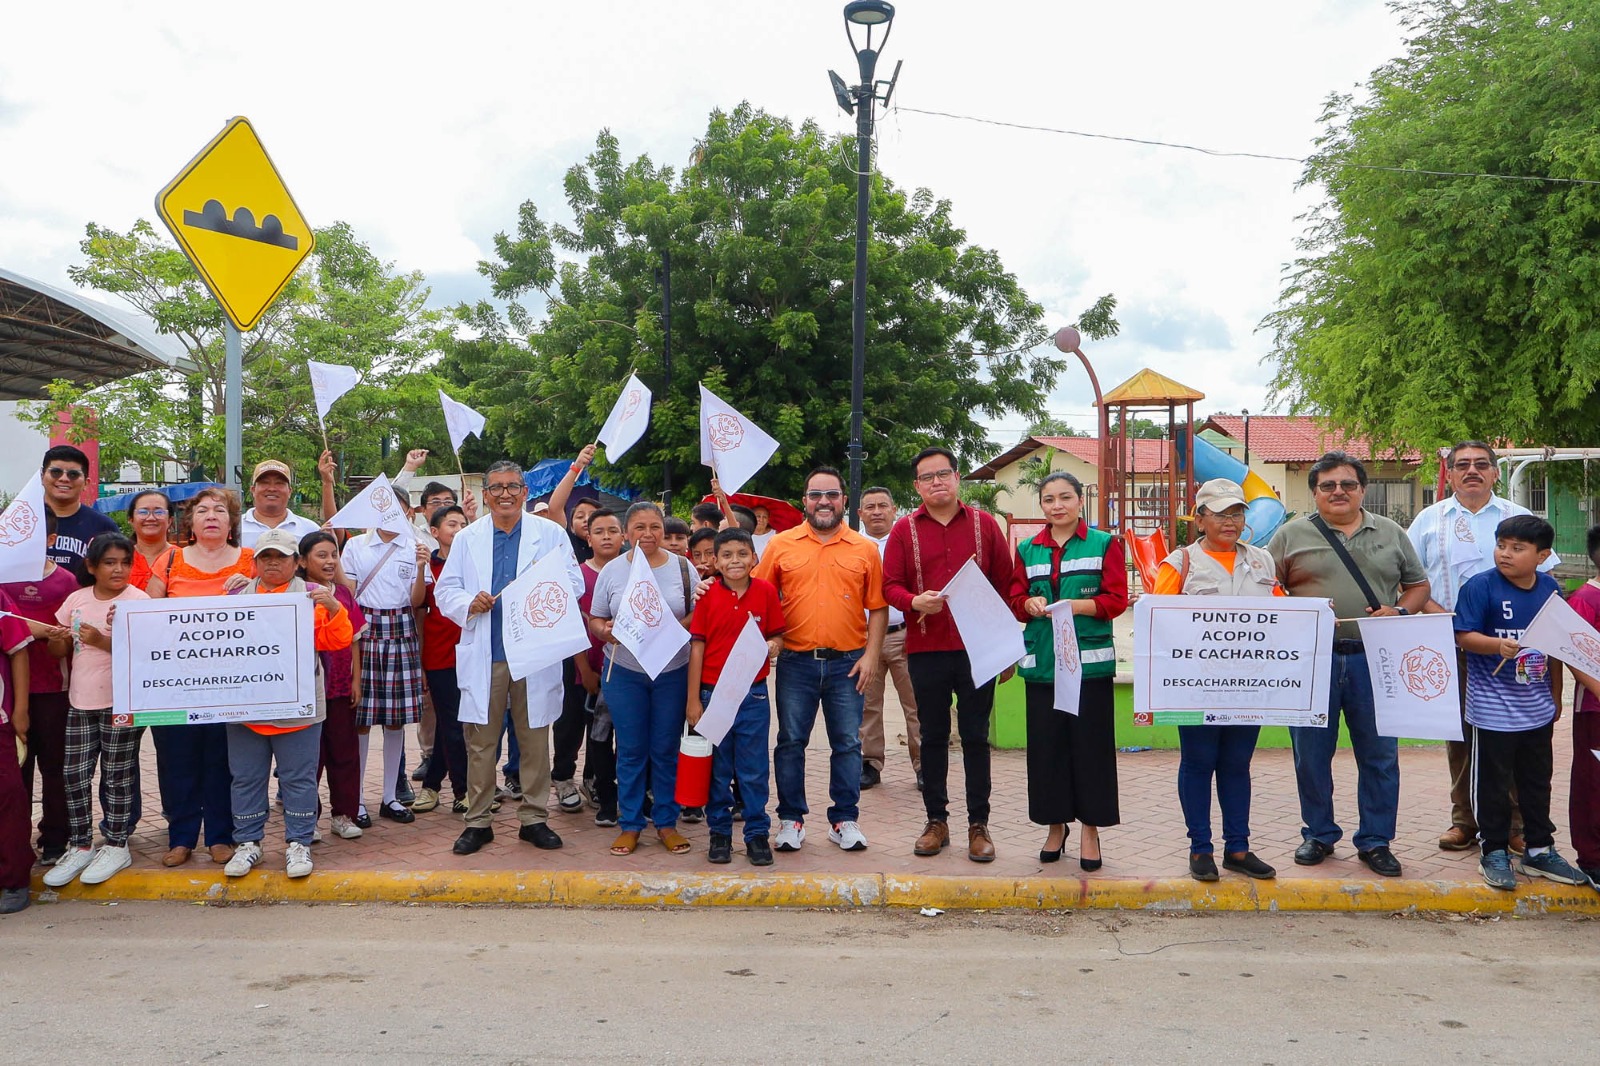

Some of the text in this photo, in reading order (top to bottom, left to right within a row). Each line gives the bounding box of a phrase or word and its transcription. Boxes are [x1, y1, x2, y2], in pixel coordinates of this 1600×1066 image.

[1502, 600, 1514, 620] 5
[169, 611, 255, 625] PUNTO DE
[1192, 612, 1278, 624] PUNTO DE
[179, 629, 245, 642] ACOPIO
[1202, 630, 1266, 642] ACOPIO
[151, 644, 280, 661] DE CACHARROS
[1172, 648, 1299, 661] DE CACHARROS
[1379, 647, 1396, 698] CALKINÍ
[143, 672, 284, 688] DESCACHARRIZACIÓN
[1163, 677, 1301, 688] DESCACHARRIZACIÓN
